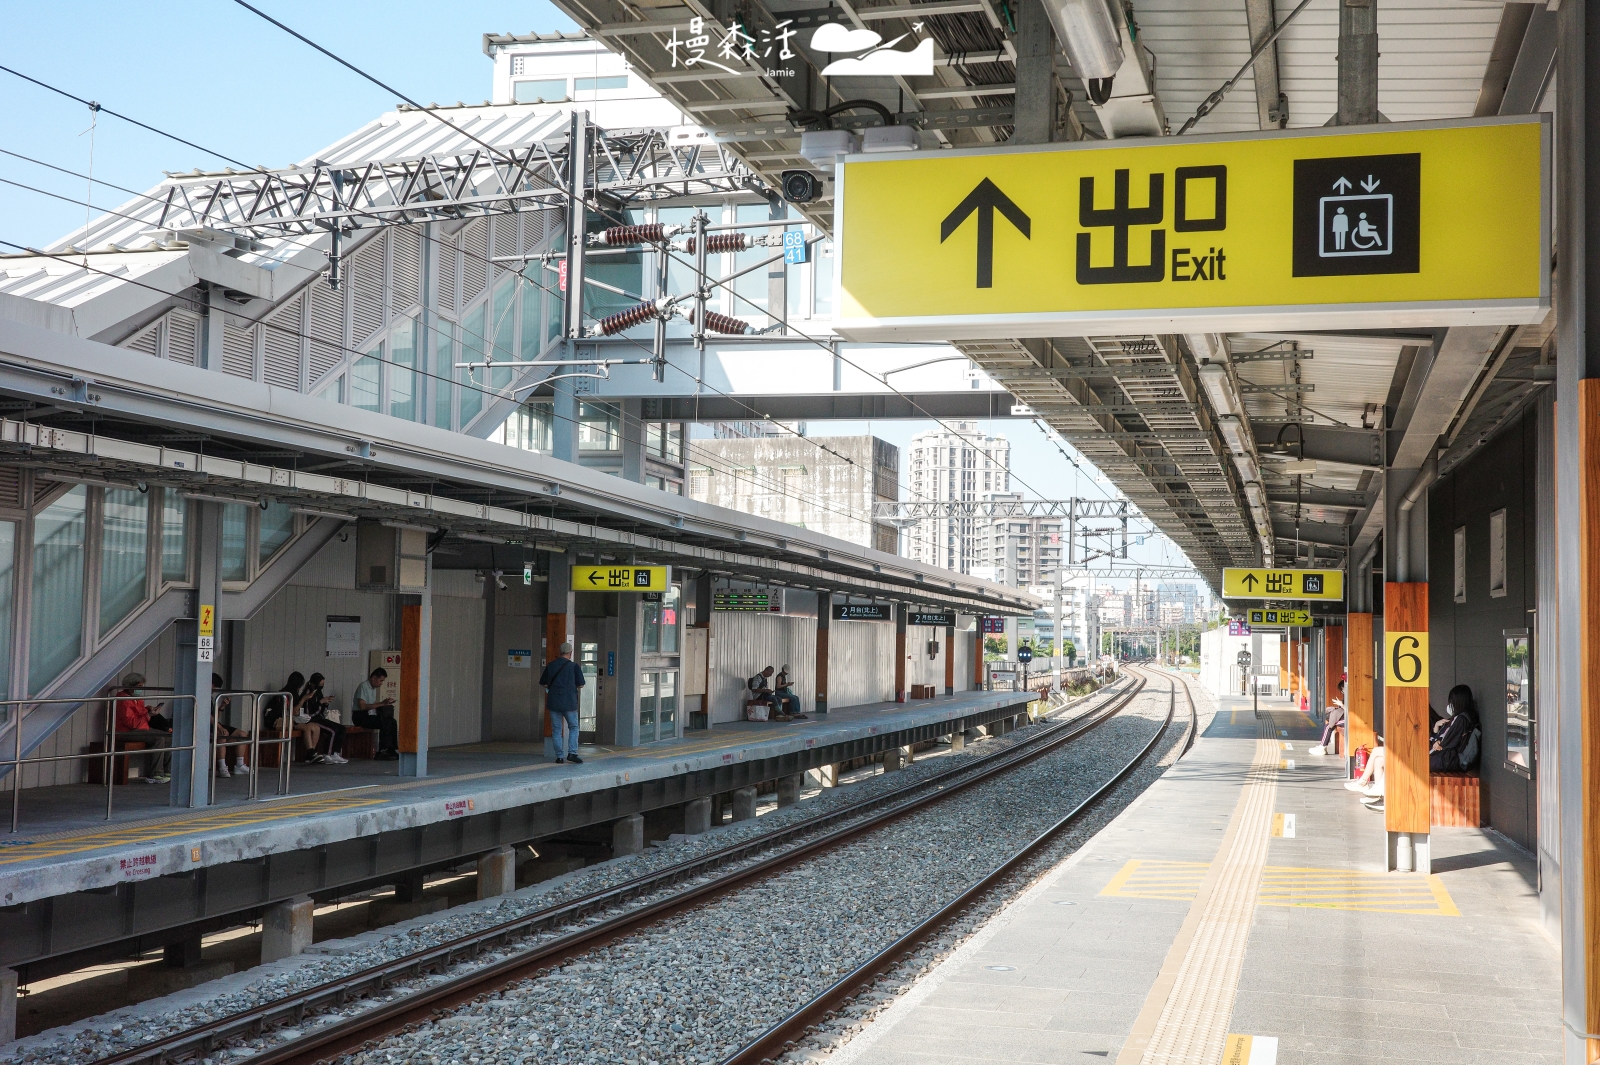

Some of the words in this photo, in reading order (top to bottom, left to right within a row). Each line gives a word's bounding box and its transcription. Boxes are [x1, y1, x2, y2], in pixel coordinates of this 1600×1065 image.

[1076, 165, 1227, 285] 出口
[785, 232, 802, 246] 68
[786, 249, 802, 261] 41
[1172, 247, 1226, 281] Exit
[608, 569, 630, 587] 出口
[1266, 573, 1292, 593] 出口
[841, 606, 848, 617] 2
[1281, 612, 1295, 623] 出口
[915, 614, 921, 623] 2
[201, 638, 211, 647] 68
[200, 650, 210, 660] 42
[1393, 635, 1422, 683] 6
